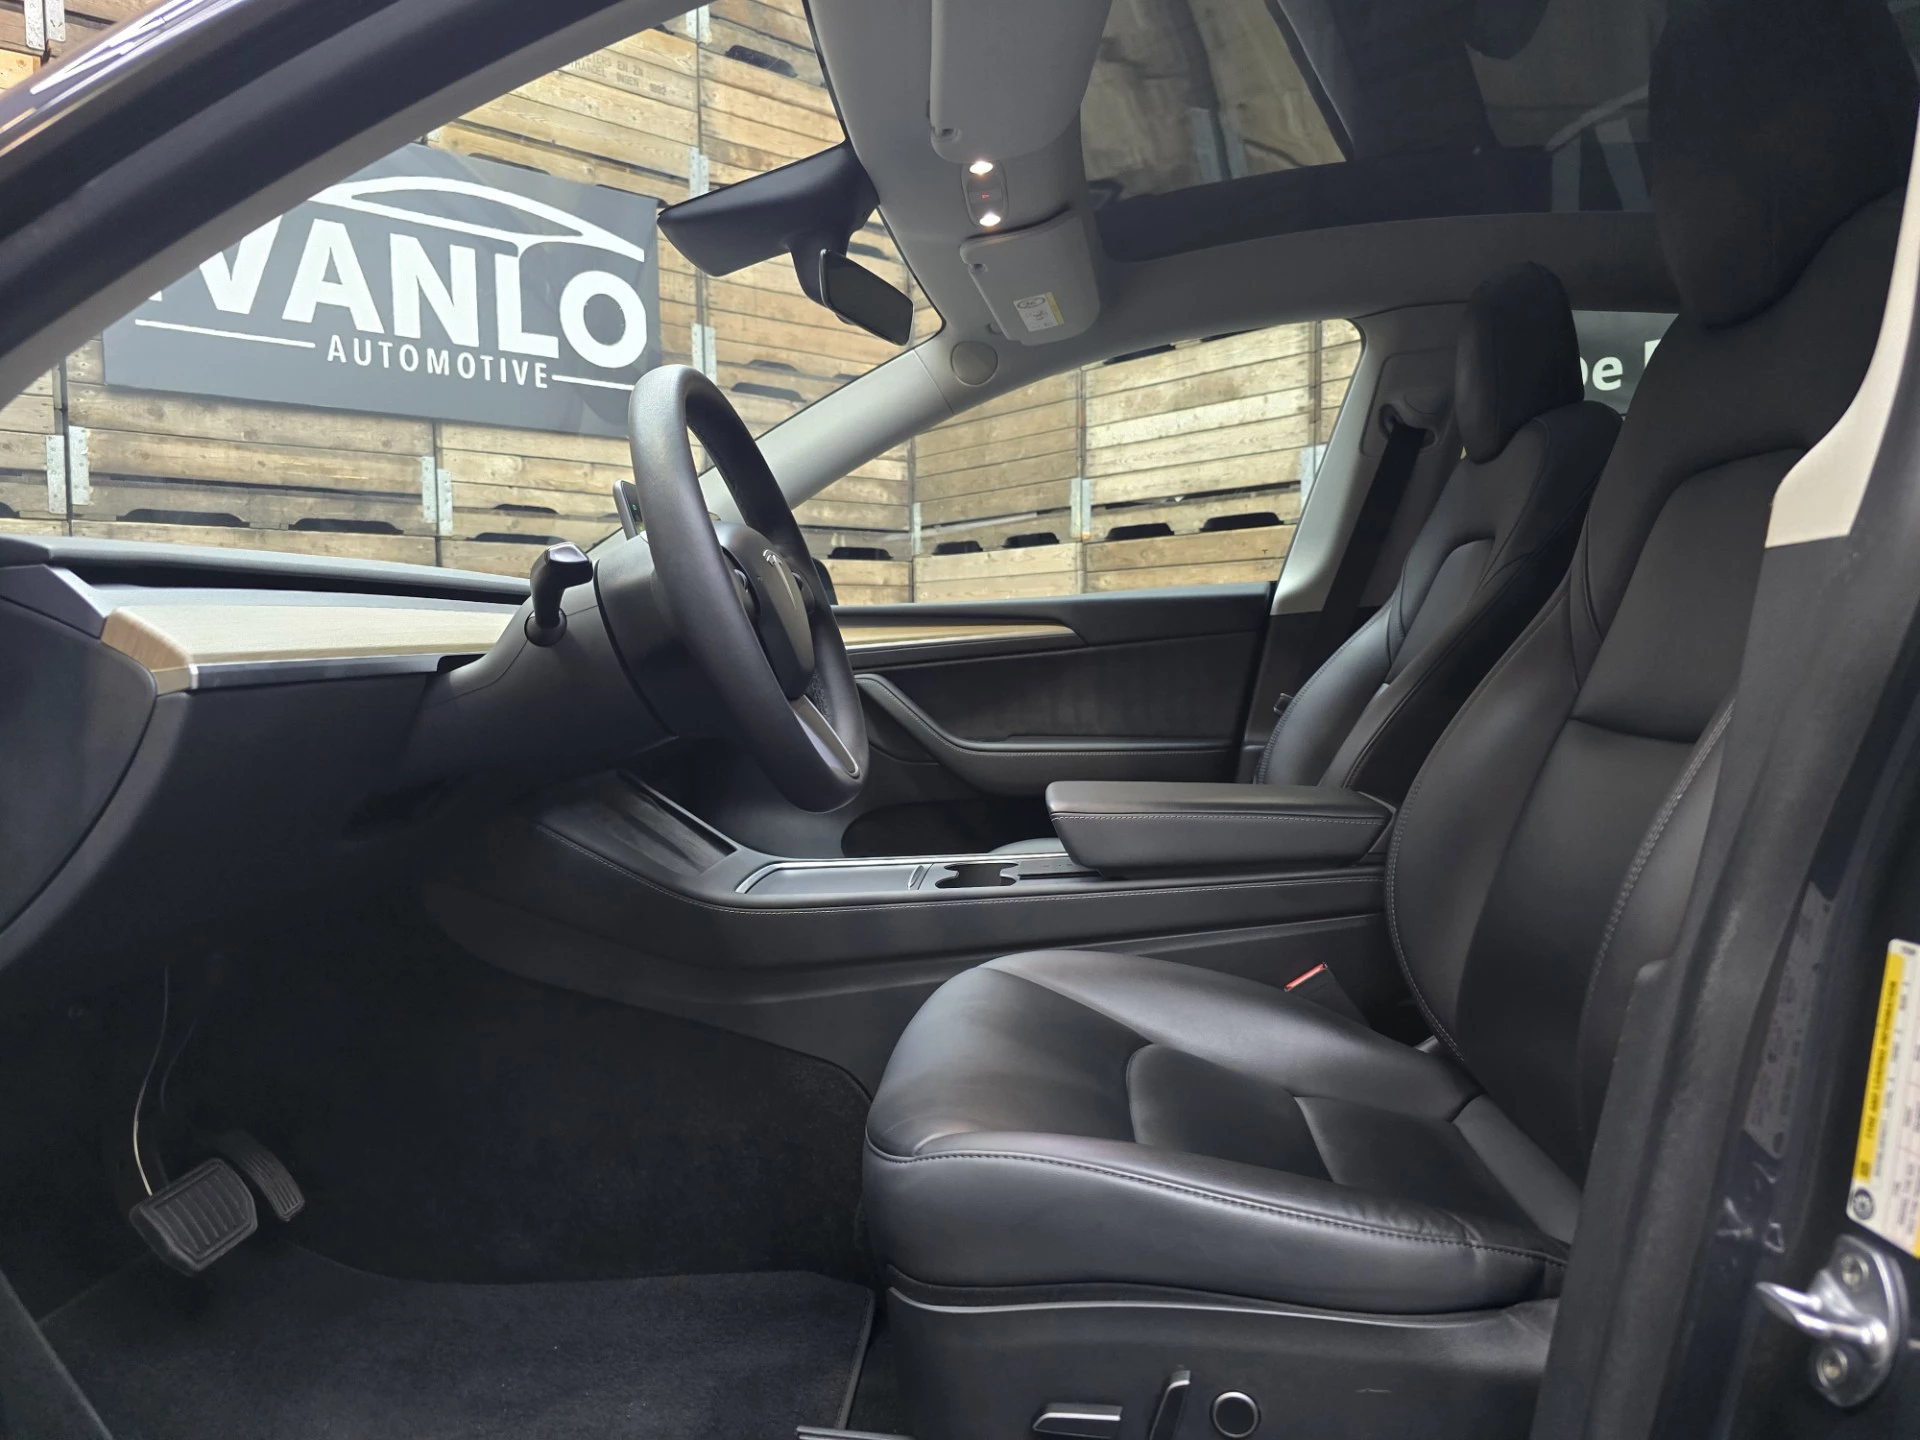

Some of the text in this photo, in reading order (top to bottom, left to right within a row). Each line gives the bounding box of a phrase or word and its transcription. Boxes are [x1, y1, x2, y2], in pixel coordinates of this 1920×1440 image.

[148, 214, 648, 369] VANLO
[326, 335, 549, 389] AUTOMOTIVE
[1580, 356, 1624, 391] e
